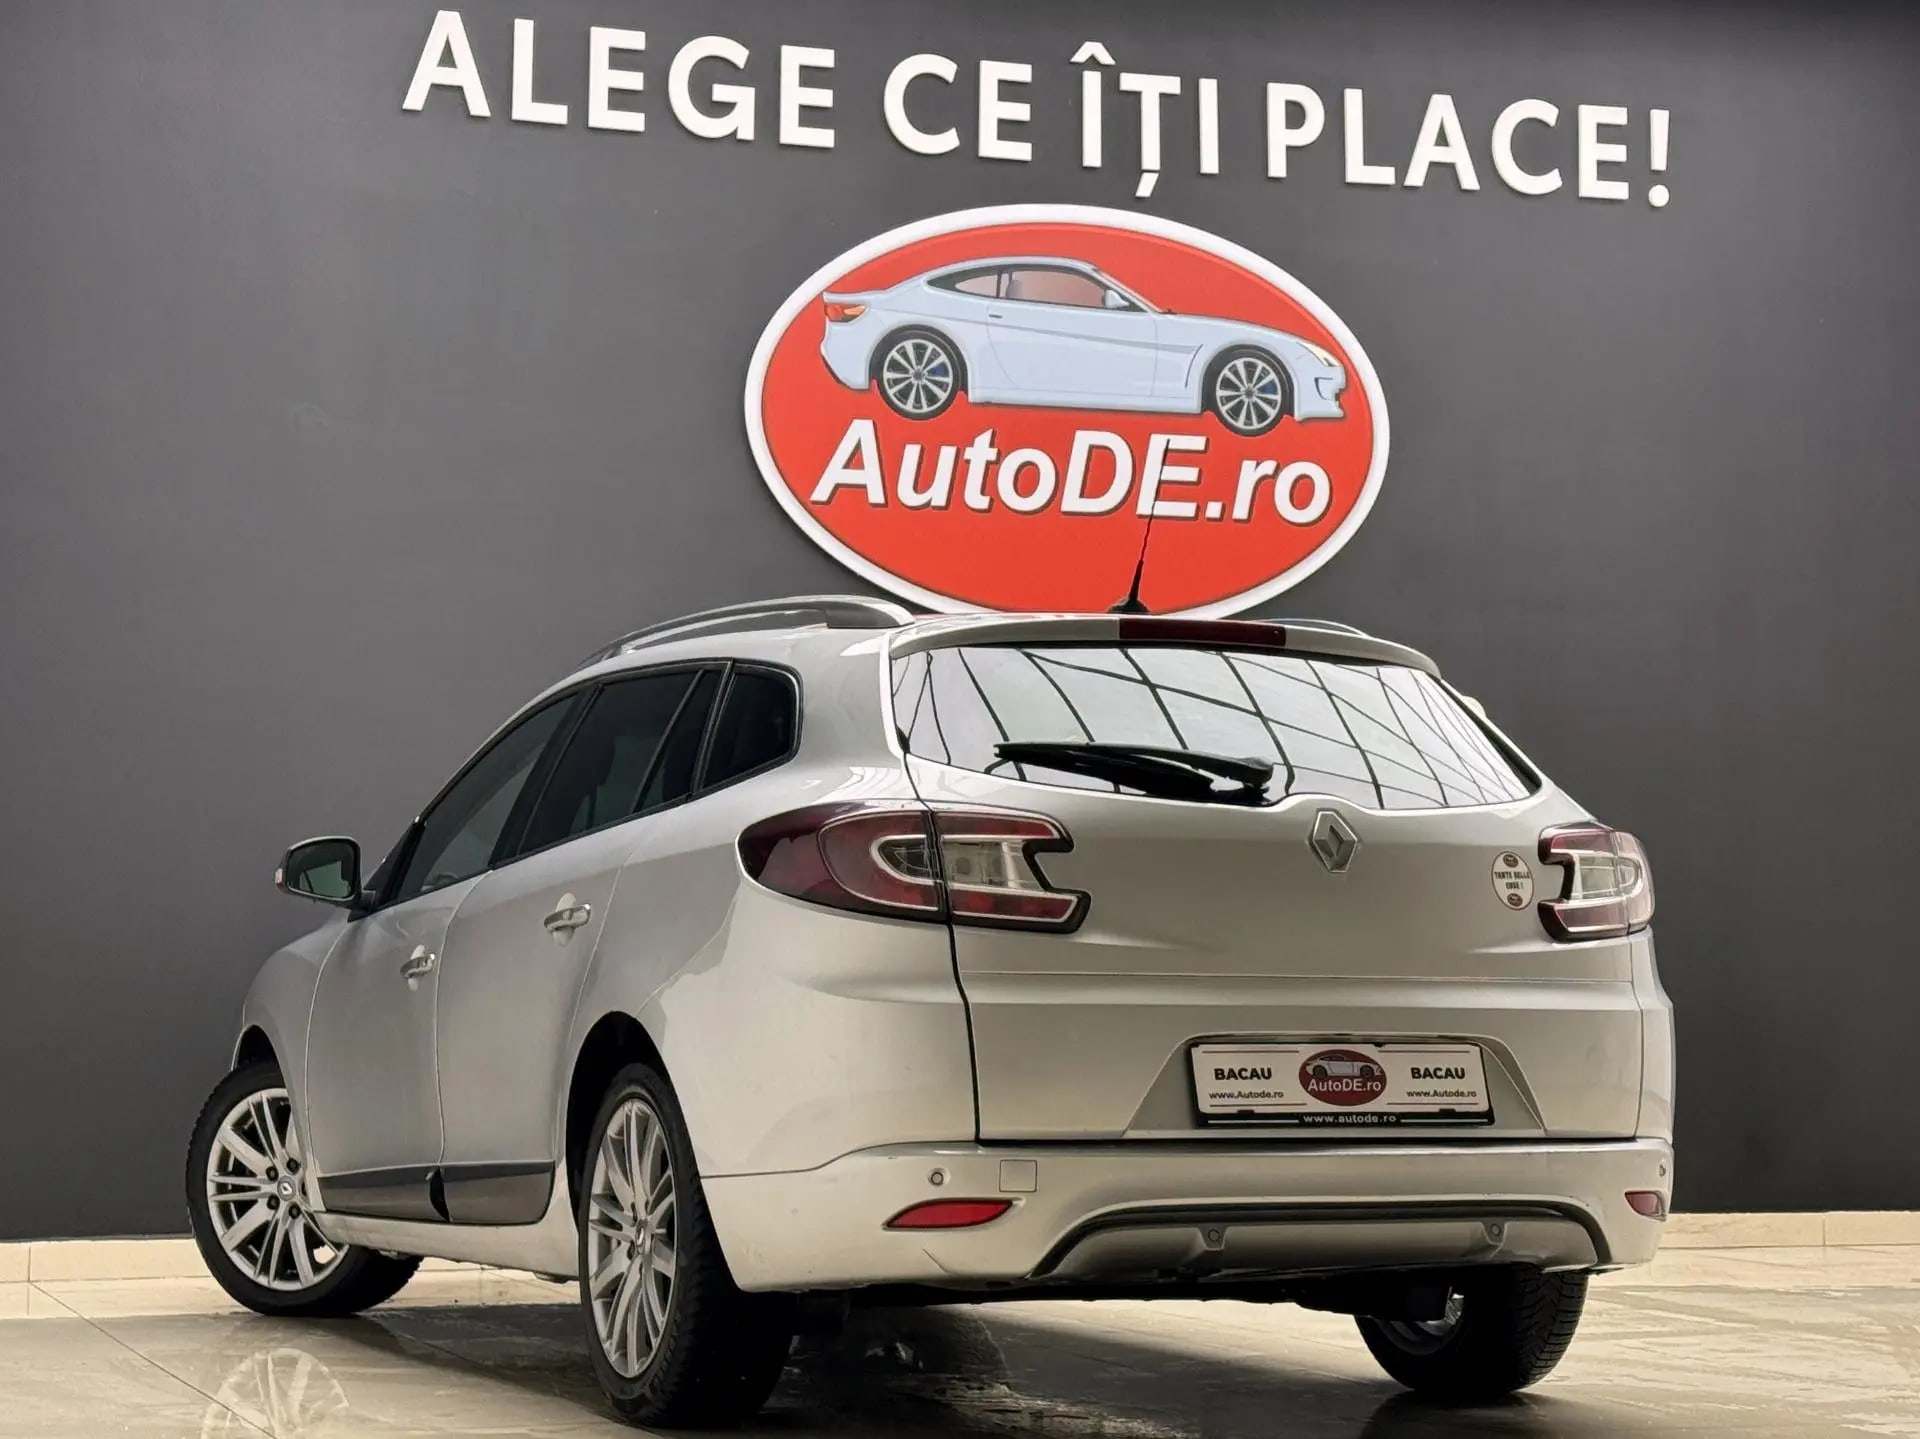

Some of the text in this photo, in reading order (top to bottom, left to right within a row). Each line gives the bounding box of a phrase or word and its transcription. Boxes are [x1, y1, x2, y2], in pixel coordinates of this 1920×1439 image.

[402, 10, 836, 149] ALEGE
[883, 53, 1032, 161] CE
[1266, 82, 1671, 208] PLACE!
[810, 419, 1331, 524] AutoDE.ro
[1213, 1066, 1273, 1081] BACAU
[1410, 1067, 1466, 1080] BACAU
[1308, 1078, 1381, 1092] AutoDE.ro
[1208, 1090, 1284, 1099] www.Autode.ro
[1406, 1089, 1477, 1098] www.Autode.ro
[1303, 1113, 1397, 1123] www.autode.ro
